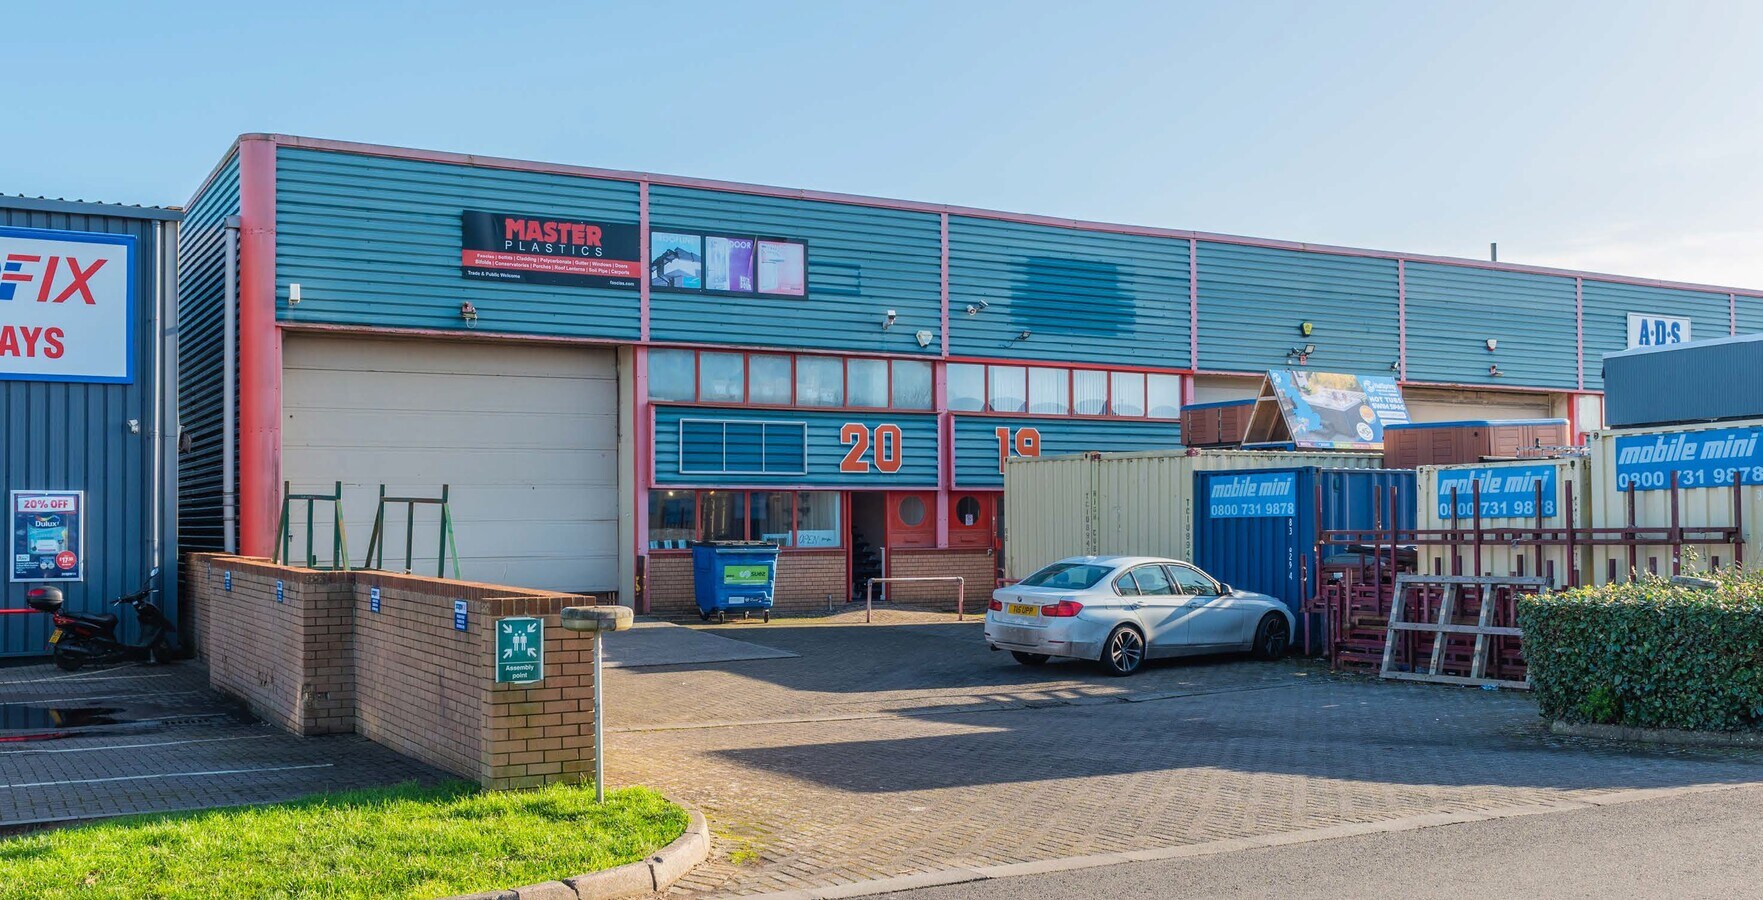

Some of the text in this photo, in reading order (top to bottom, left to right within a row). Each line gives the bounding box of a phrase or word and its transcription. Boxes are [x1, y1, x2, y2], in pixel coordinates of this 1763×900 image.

[505, 218, 602, 247] MASTER
[505, 240, 603, 257] PLASTICS
[540, 257, 572, 265] Polycarbonate
[0, 254, 108, 305] FIX
[840, 422, 902, 473] 20
[995, 426, 1041, 475] 19
[1618, 432, 1759, 465] mobile mini
[1440, 470, 1502, 495] mobile
[1619, 466, 1763, 488] 0800 31 9878
[1211, 476, 1293, 498] mobile mini
[24, 499, 69, 509] 20% OFF
[1211, 502, 1294, 516] 0800 731 9878
[1440, 500, 1554, 516] 000 731 988
[35, 520, 57, 528] Dulux
[799, 533, 819, 545] OPEN
[505, 664, 534, 672] Assembly
[512, 672, 528, 680] point
